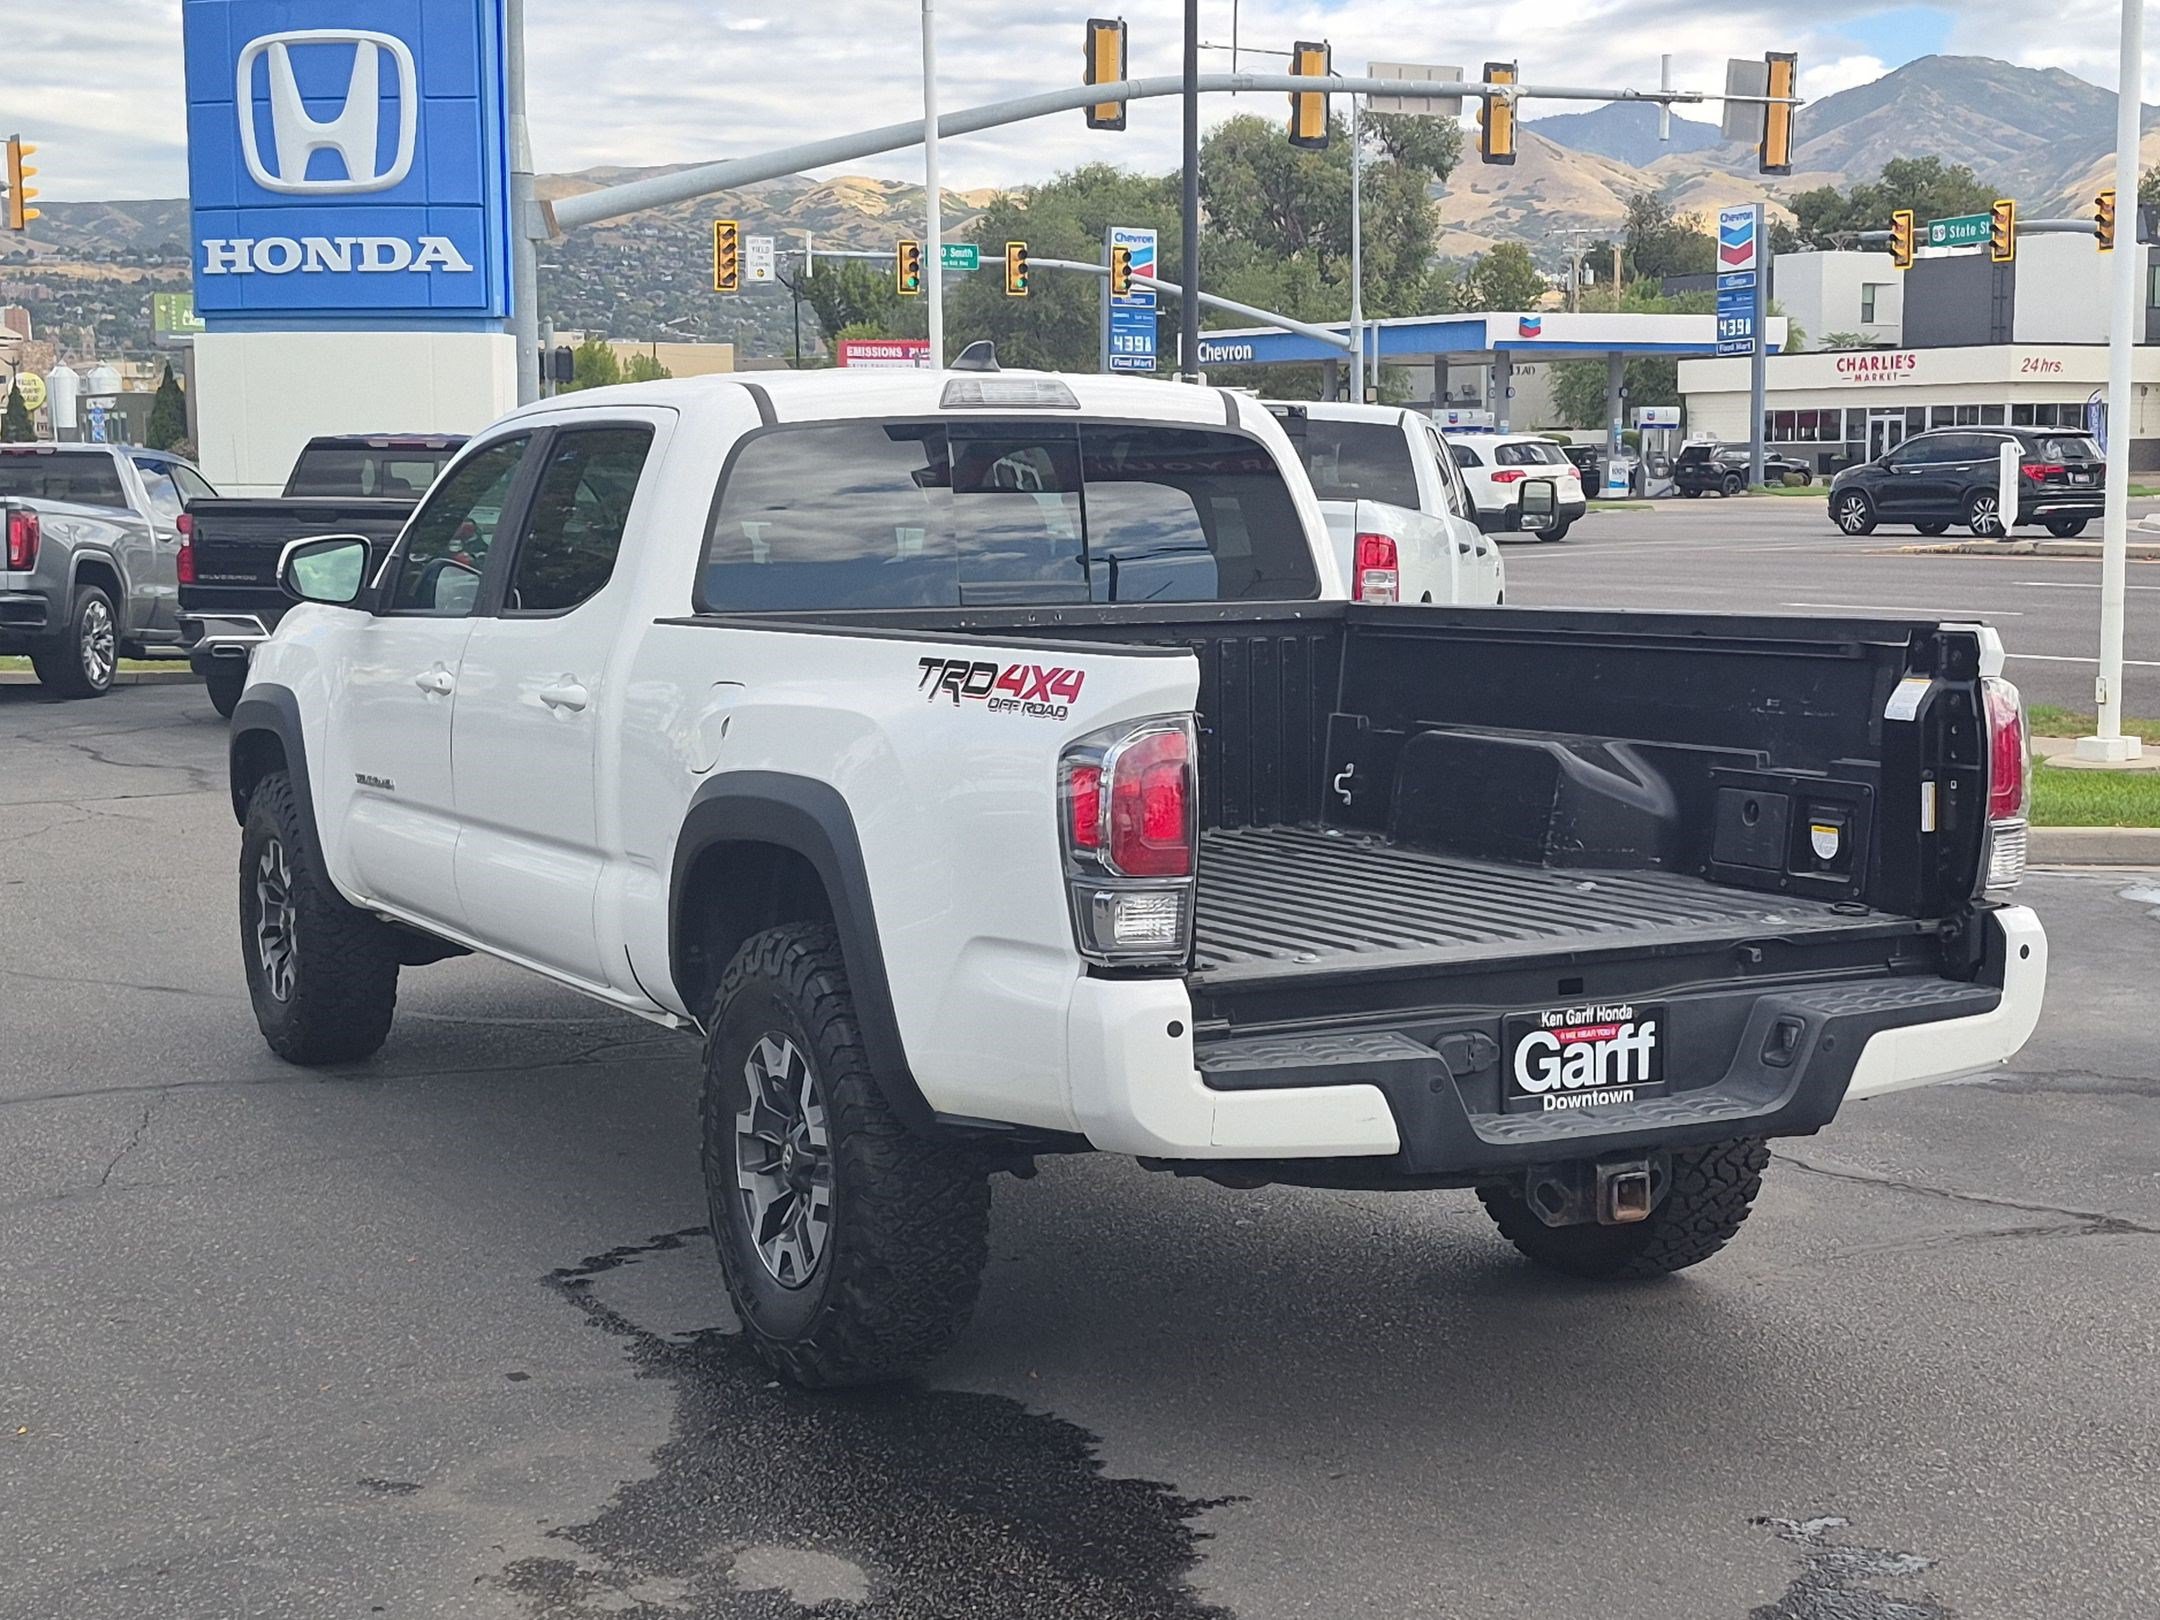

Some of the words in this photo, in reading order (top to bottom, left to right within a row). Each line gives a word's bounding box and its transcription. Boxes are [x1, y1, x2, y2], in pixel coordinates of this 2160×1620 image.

[1720, 211, 1754, 223] Chevron
[1114, 232, 1154, 243] Chevron
[1949, 224, 1976, 238] State
[1980, 221, 1990, 235] St
[202, 237, 473, 274] HONDA
[950, 247, 974, 258] South
[846, 346, 903, 358] EMISSIONS
[1197, 343, 1252, 362] Chevron
[1836, 354, 1916, 373] CHARLIE'S
[2020, 357, 2038, 373] 24
[2039, 358, 2064, 373] hrs.
[1854, 372, 1899, 382] MARKET
[918, 657, 999, 707] TRD
[996, 664, 1085, 704] 4X4
[988, 697, 1021, 715] OFF
[1021, 702, 1069, 721] ROAD
[1541, 1011, 1563, 1028] Ken
[1565, 1006, 1594, 1026] Garff
[1596, 1005, 1633, 1023] Honda
[1514, 1021, 1656, 1093] Garff
[1543, 1089, 1634, 1112] Downtown
